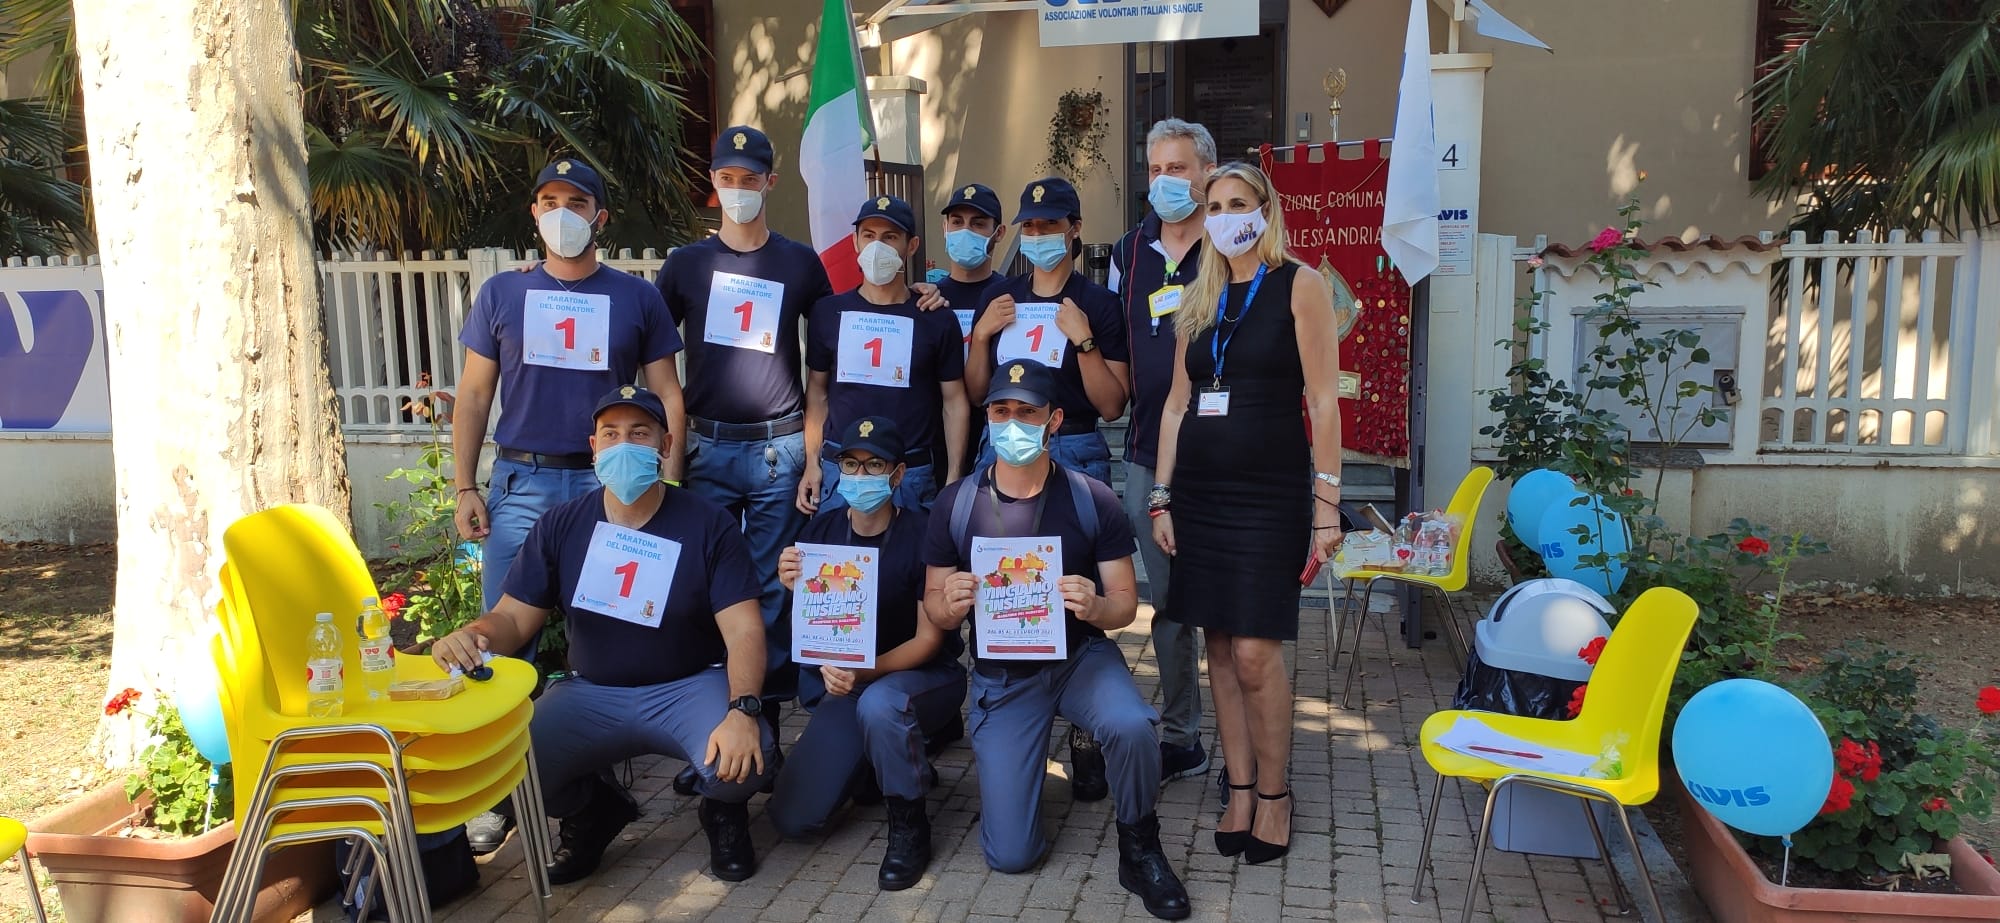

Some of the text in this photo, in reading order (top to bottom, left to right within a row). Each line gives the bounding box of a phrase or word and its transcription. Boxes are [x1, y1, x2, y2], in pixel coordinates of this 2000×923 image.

[1045, 3, 1203, 21] ASSOCIAZIONE VOLONTARI ITALIANI SANGUE
[1442, 144, 1459, 167] 4
[1328, 191, 1384, 208] COMUNA
[723, 285, 773, 299] DEL DONATORE
[730, 278, 768, 290] MARATONA
[547, 295, 589, 305] MARATONA
[555, 305, 597, 313] DONATORE
[734, 301, 753, 332] 1
[858, 317, 895, 325] MARATONA
[555, 317, 575, 350] 1
[865, 325, 901, 334] DONATORE
[1026, 324, 1043, 352] 1
[864, 337, 882, 367] 1
[616, 532, 658, 549] MARATONA
[606, 540, 662, 561] DEL DONATORE
[614, 561, 639, 598] 1
[985, 582, 1054, 600] VINCIAMO
[805, 602, 862, 617] INSIEME
[988, 593, 1049, 613] INSIEME
[1688, 780, 1770, 807] AVIS
